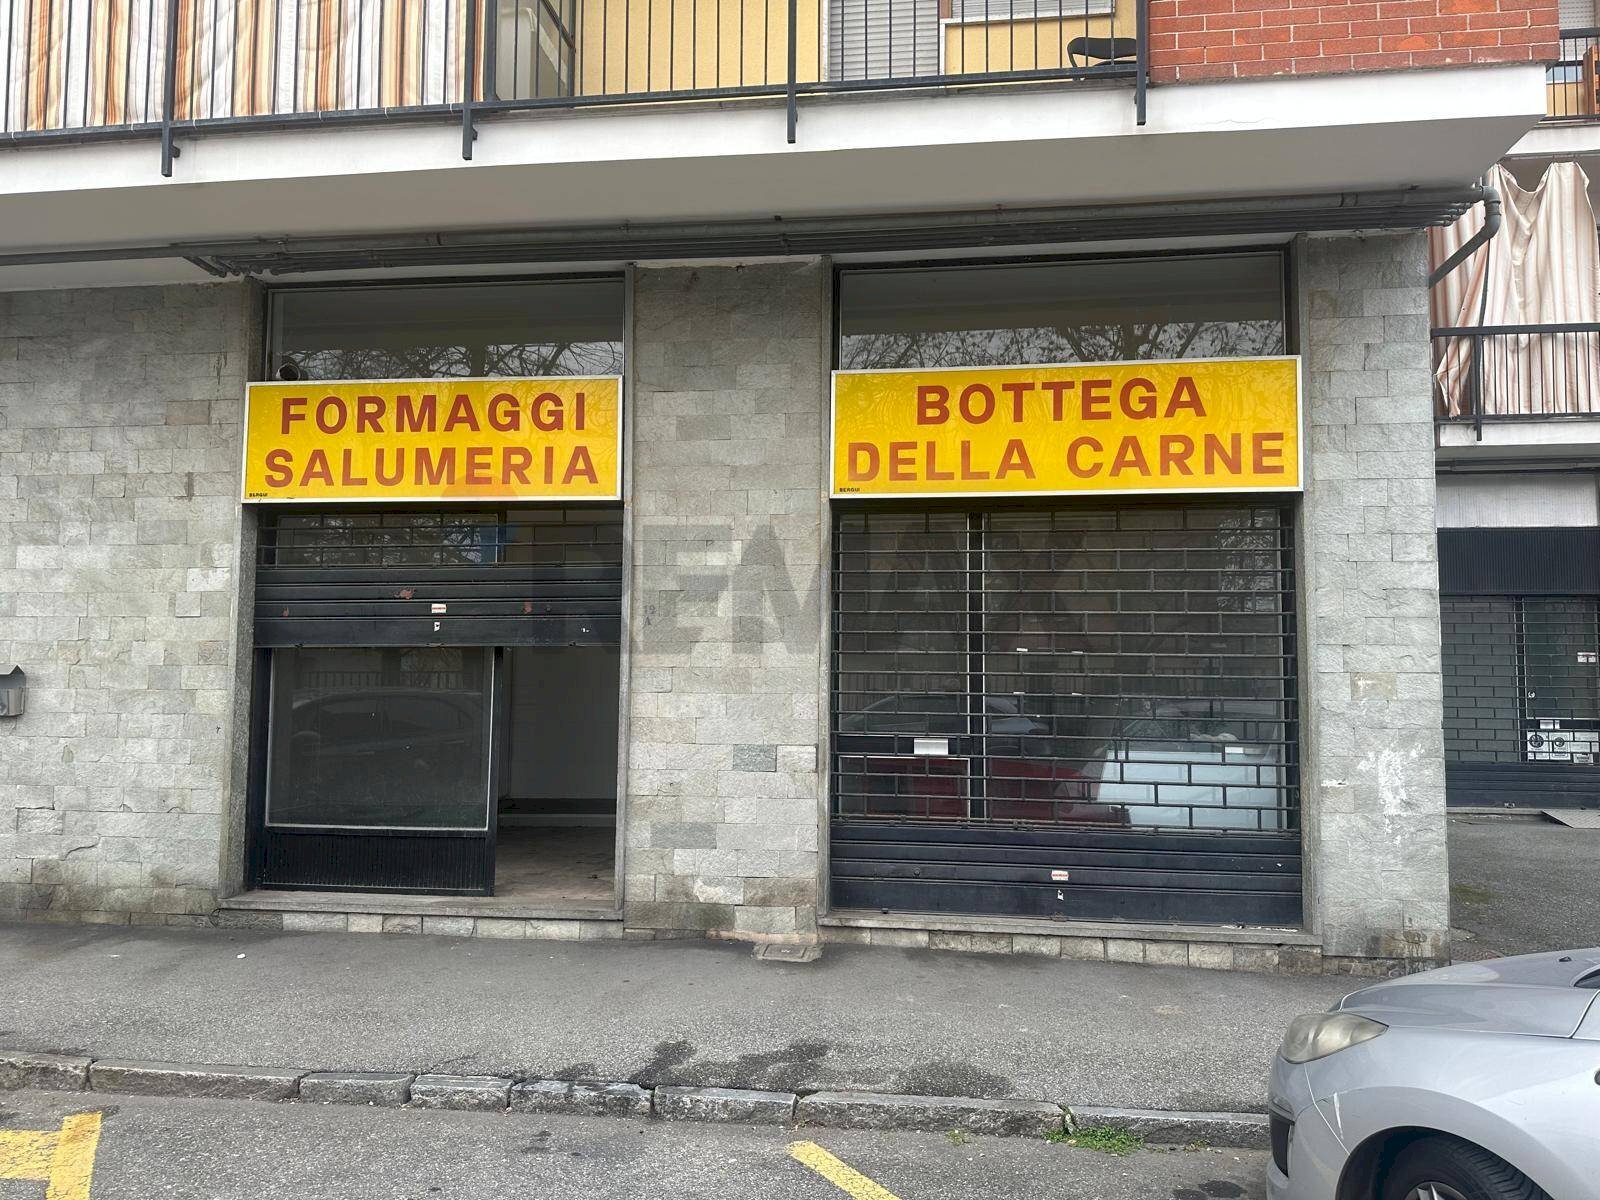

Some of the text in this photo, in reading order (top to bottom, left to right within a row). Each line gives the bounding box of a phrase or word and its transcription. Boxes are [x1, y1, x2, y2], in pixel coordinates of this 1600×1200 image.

[280, 392, 586, 435] FORMAGGI
[916, 376, 1207, 426] BOTTEGA
[264, 446, 598, 488] SALUMERIA
[847, 432, 1285, 482] DELLA CARNE
